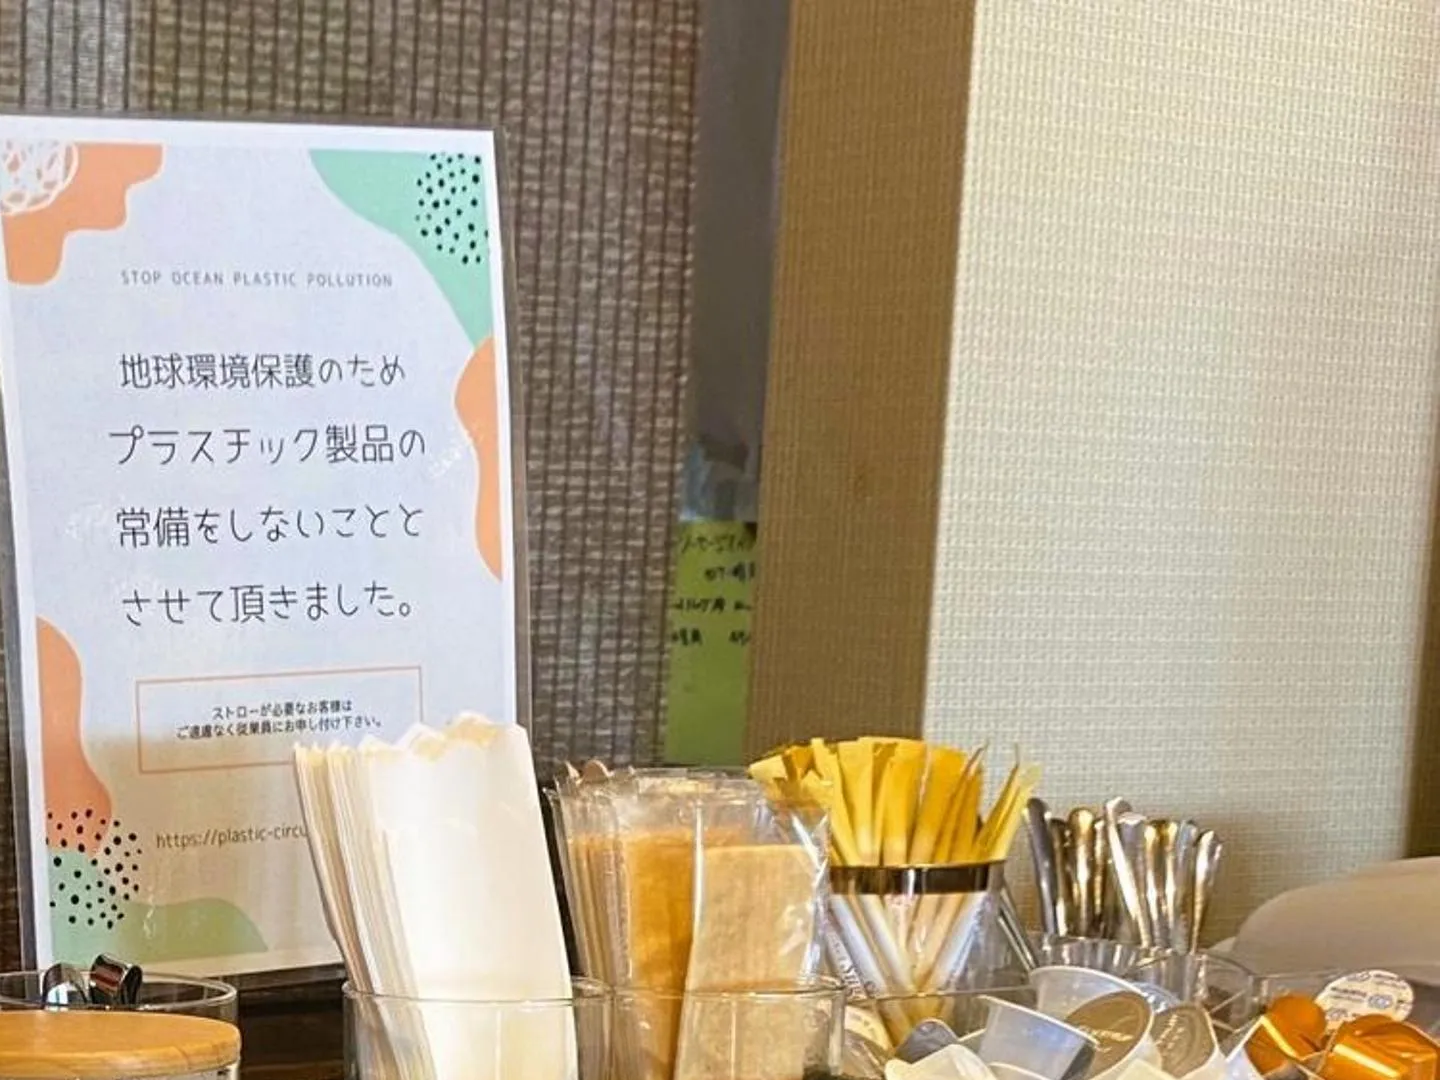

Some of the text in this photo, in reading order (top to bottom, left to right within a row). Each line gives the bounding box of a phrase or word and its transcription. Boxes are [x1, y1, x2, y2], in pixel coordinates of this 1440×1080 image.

[120, 270, 393, 288] STOP OCEAN PLASTIC POLLUTION
[119, 352, 407, 391] 地球環境保護のため
[109, 424, 426, 465] プラスチック製品の
[116, 503, 424, 548] 常備をしないことと
[122, 580, 411, 626] させて頂きました。
[211, 699, 353, 720] ストローが必要なお客様は
